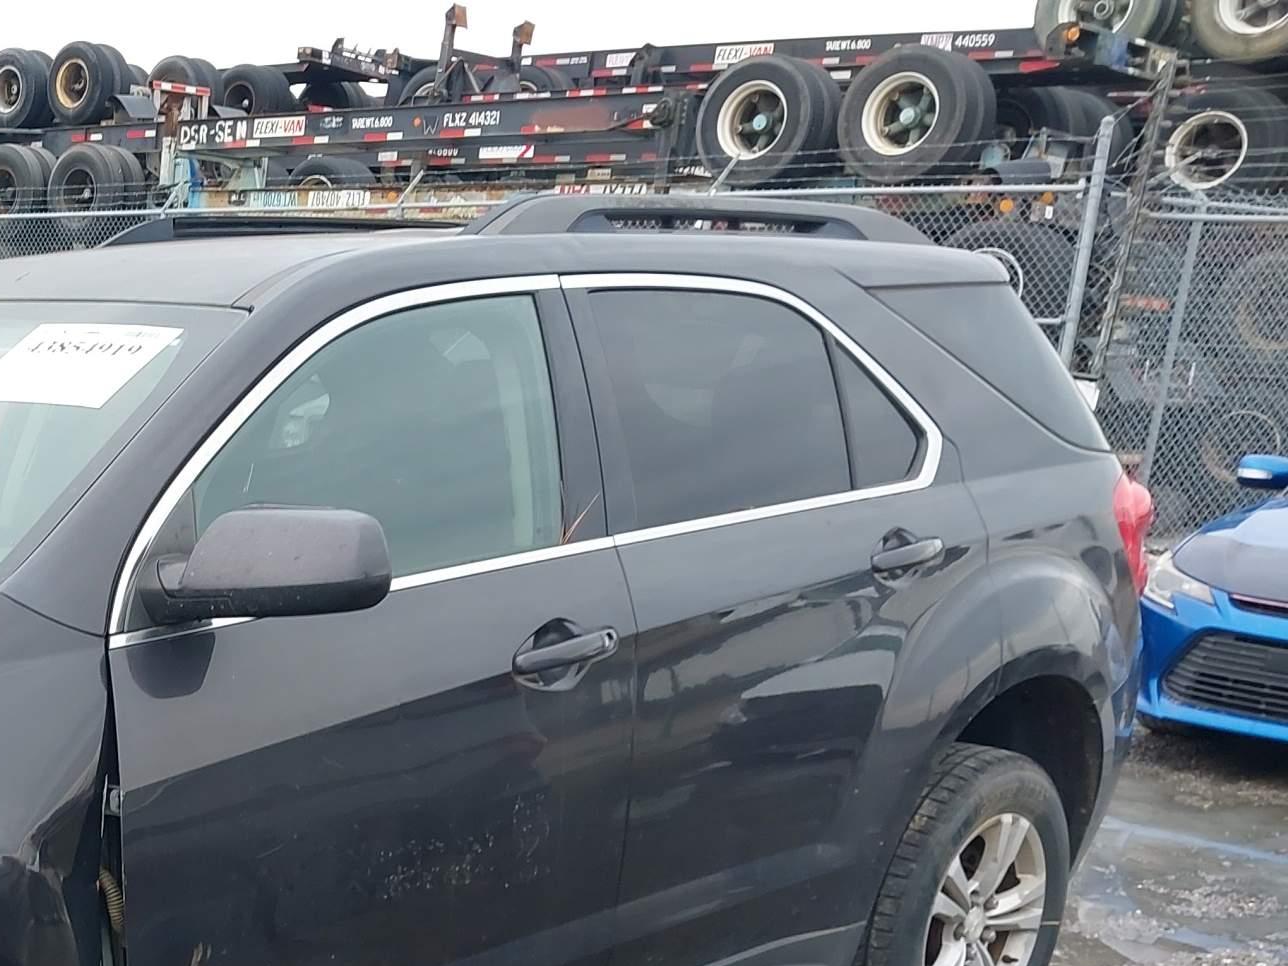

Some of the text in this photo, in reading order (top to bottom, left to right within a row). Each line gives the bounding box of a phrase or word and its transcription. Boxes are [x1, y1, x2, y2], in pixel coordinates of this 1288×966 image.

[955, 33, 996, 48] 440559
[254, 118, 304, 136] FLEXI-VAN
[443, 110, 501, 128] FLXZ 414321
